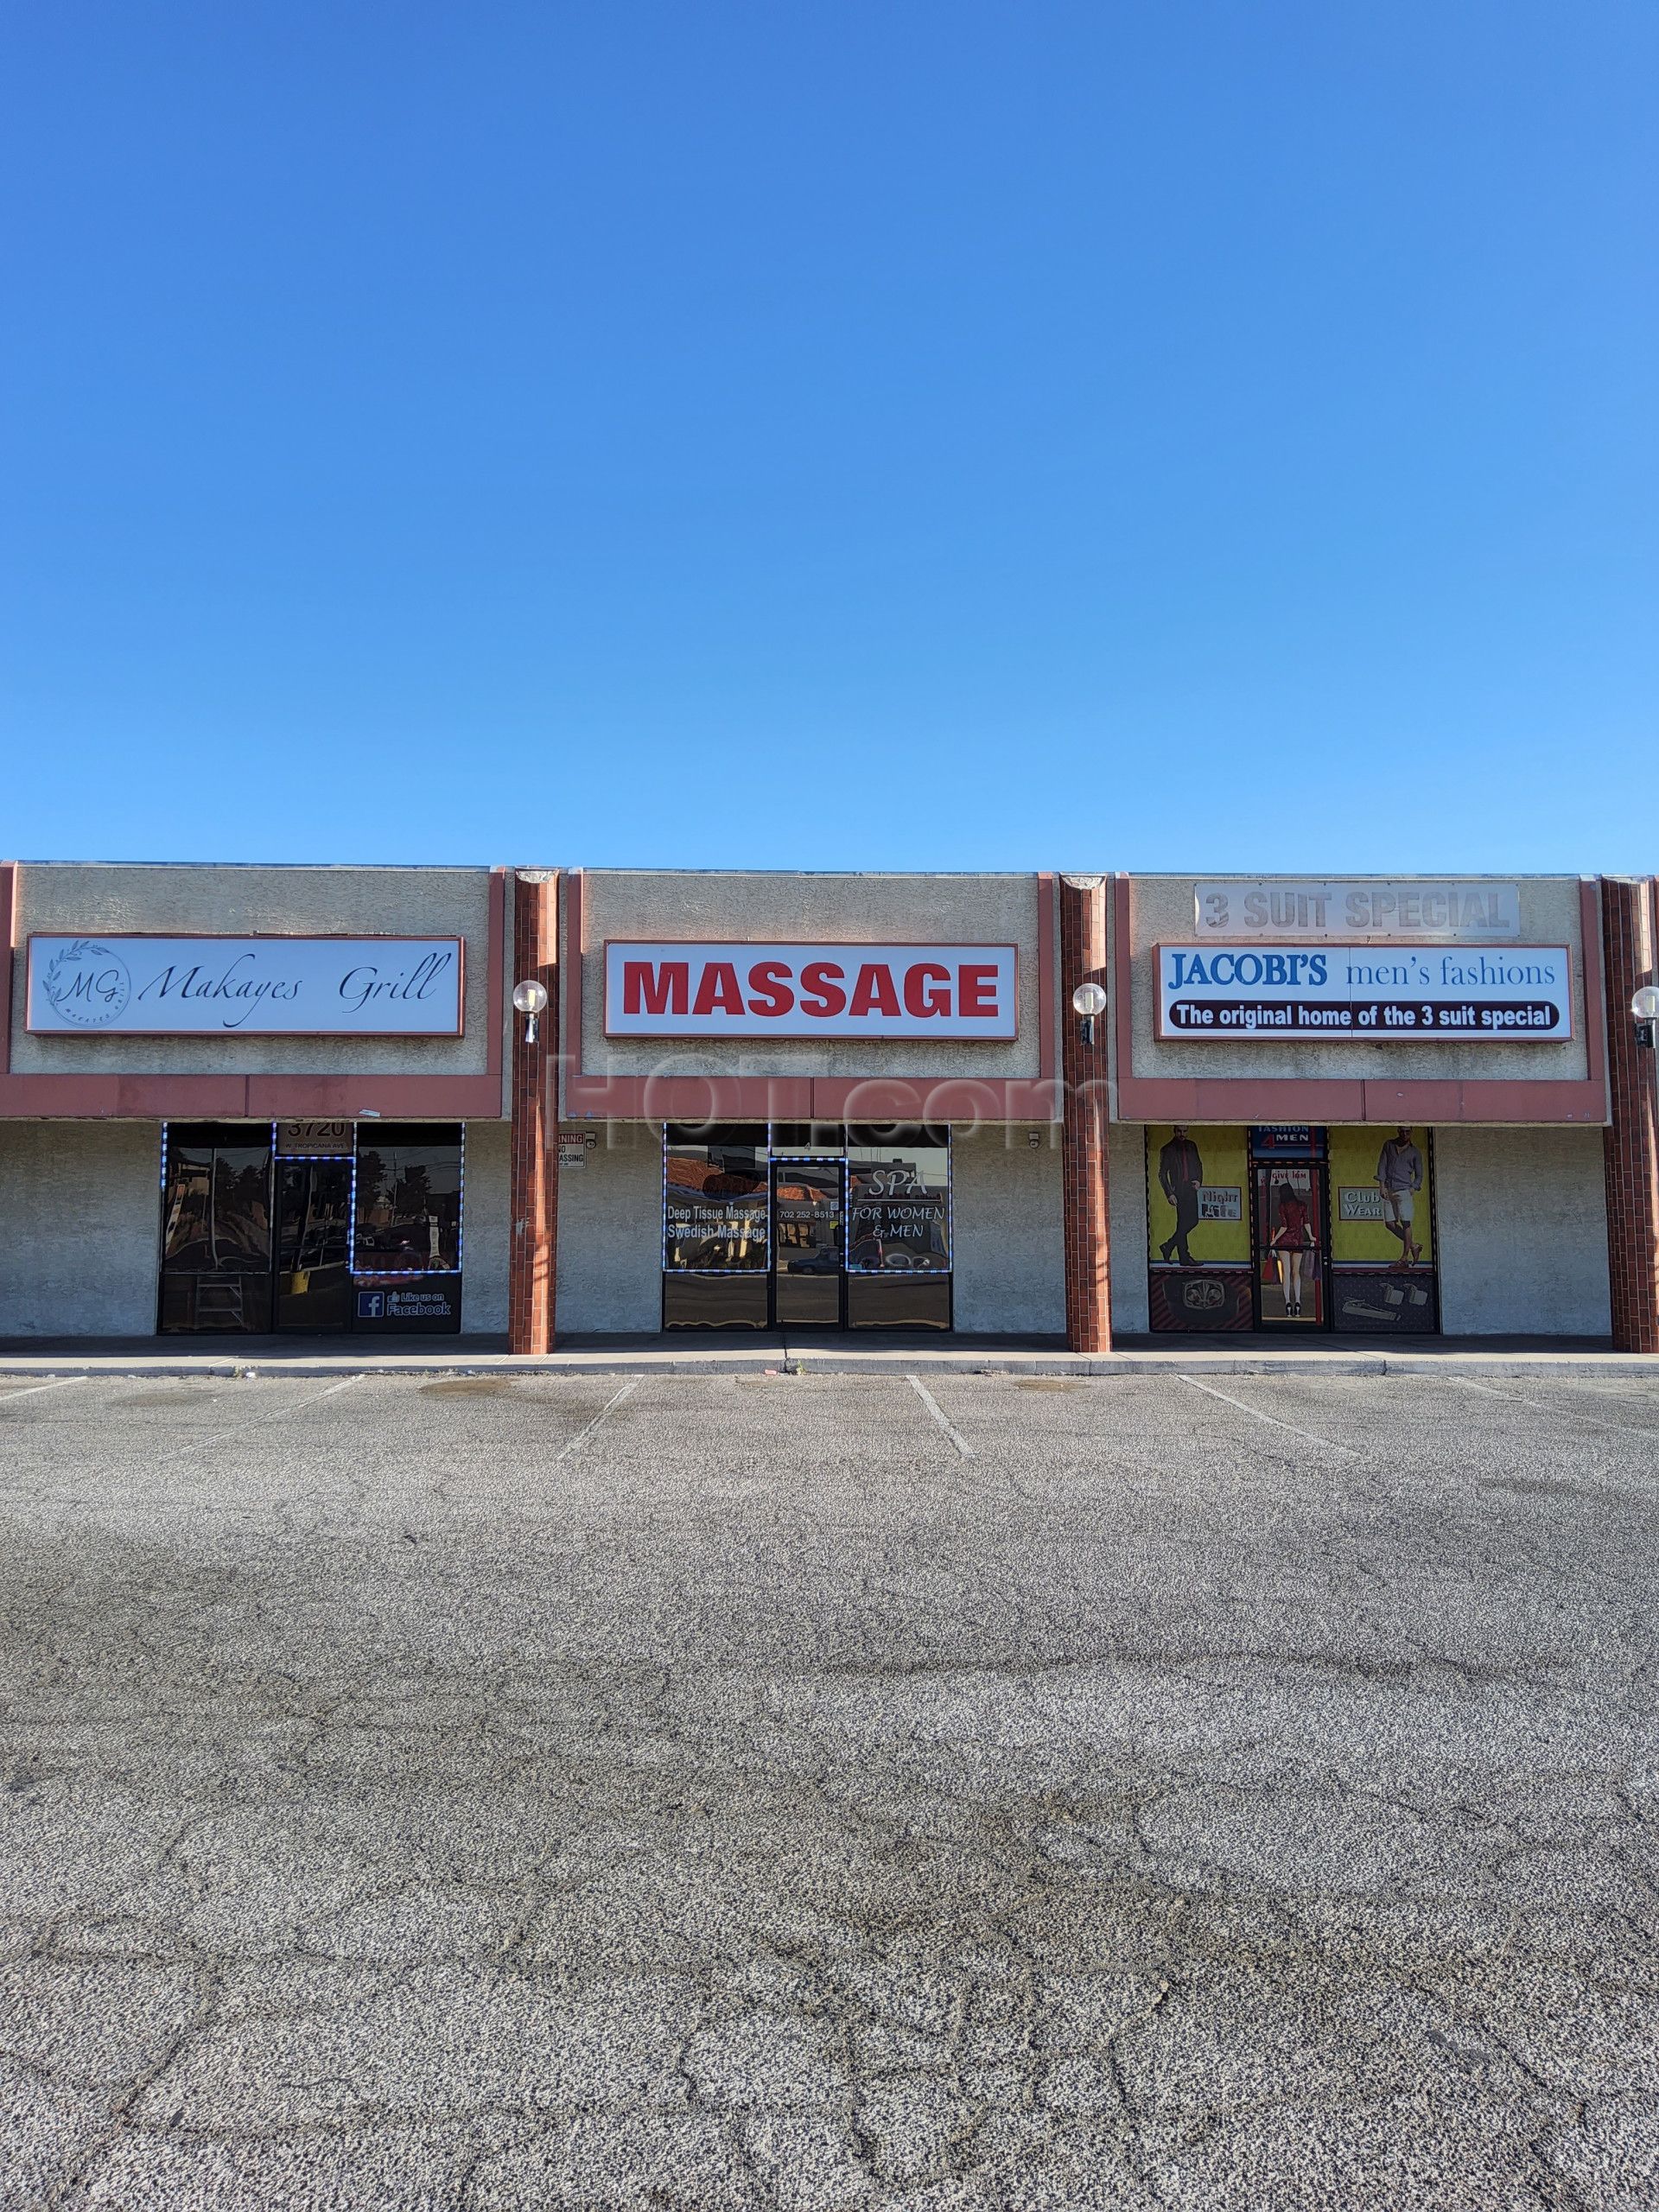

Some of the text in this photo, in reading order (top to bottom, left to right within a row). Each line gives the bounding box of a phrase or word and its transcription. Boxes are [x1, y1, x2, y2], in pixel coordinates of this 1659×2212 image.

[1205, 892, 1510, 928] 3 SUIT SPECIAL
[1168, 953, 1555, 989] JACOBI'S men's fashions
[56, 969, 119, 1002] MG
[138, 953, 303, 1027] Makayes
[339, 952, 452, 1014] Grill
[623, 961, 999, 1018] MASSAGE
[1176, 1004, 1551, 1029] The original home of the 3 suit special
[558, 1134, 582, 1143] NING
[558, 1154, 583, 1162] ASSING
[868, 1169, 928, 1196] SPA
[668, 1205, 766, 1223] Deep Tissue Massage
[853, 1207, 882, 1221] FOR
[887, 1206, 945, 1220] WOMEN
[668, 1224, 766, 1242] Swedish Massage
[873, 1224, 924, 1237] & MEN
[401, 1293, 419, 1302] Like
[387, 1301, 451, 1316] Facebook
